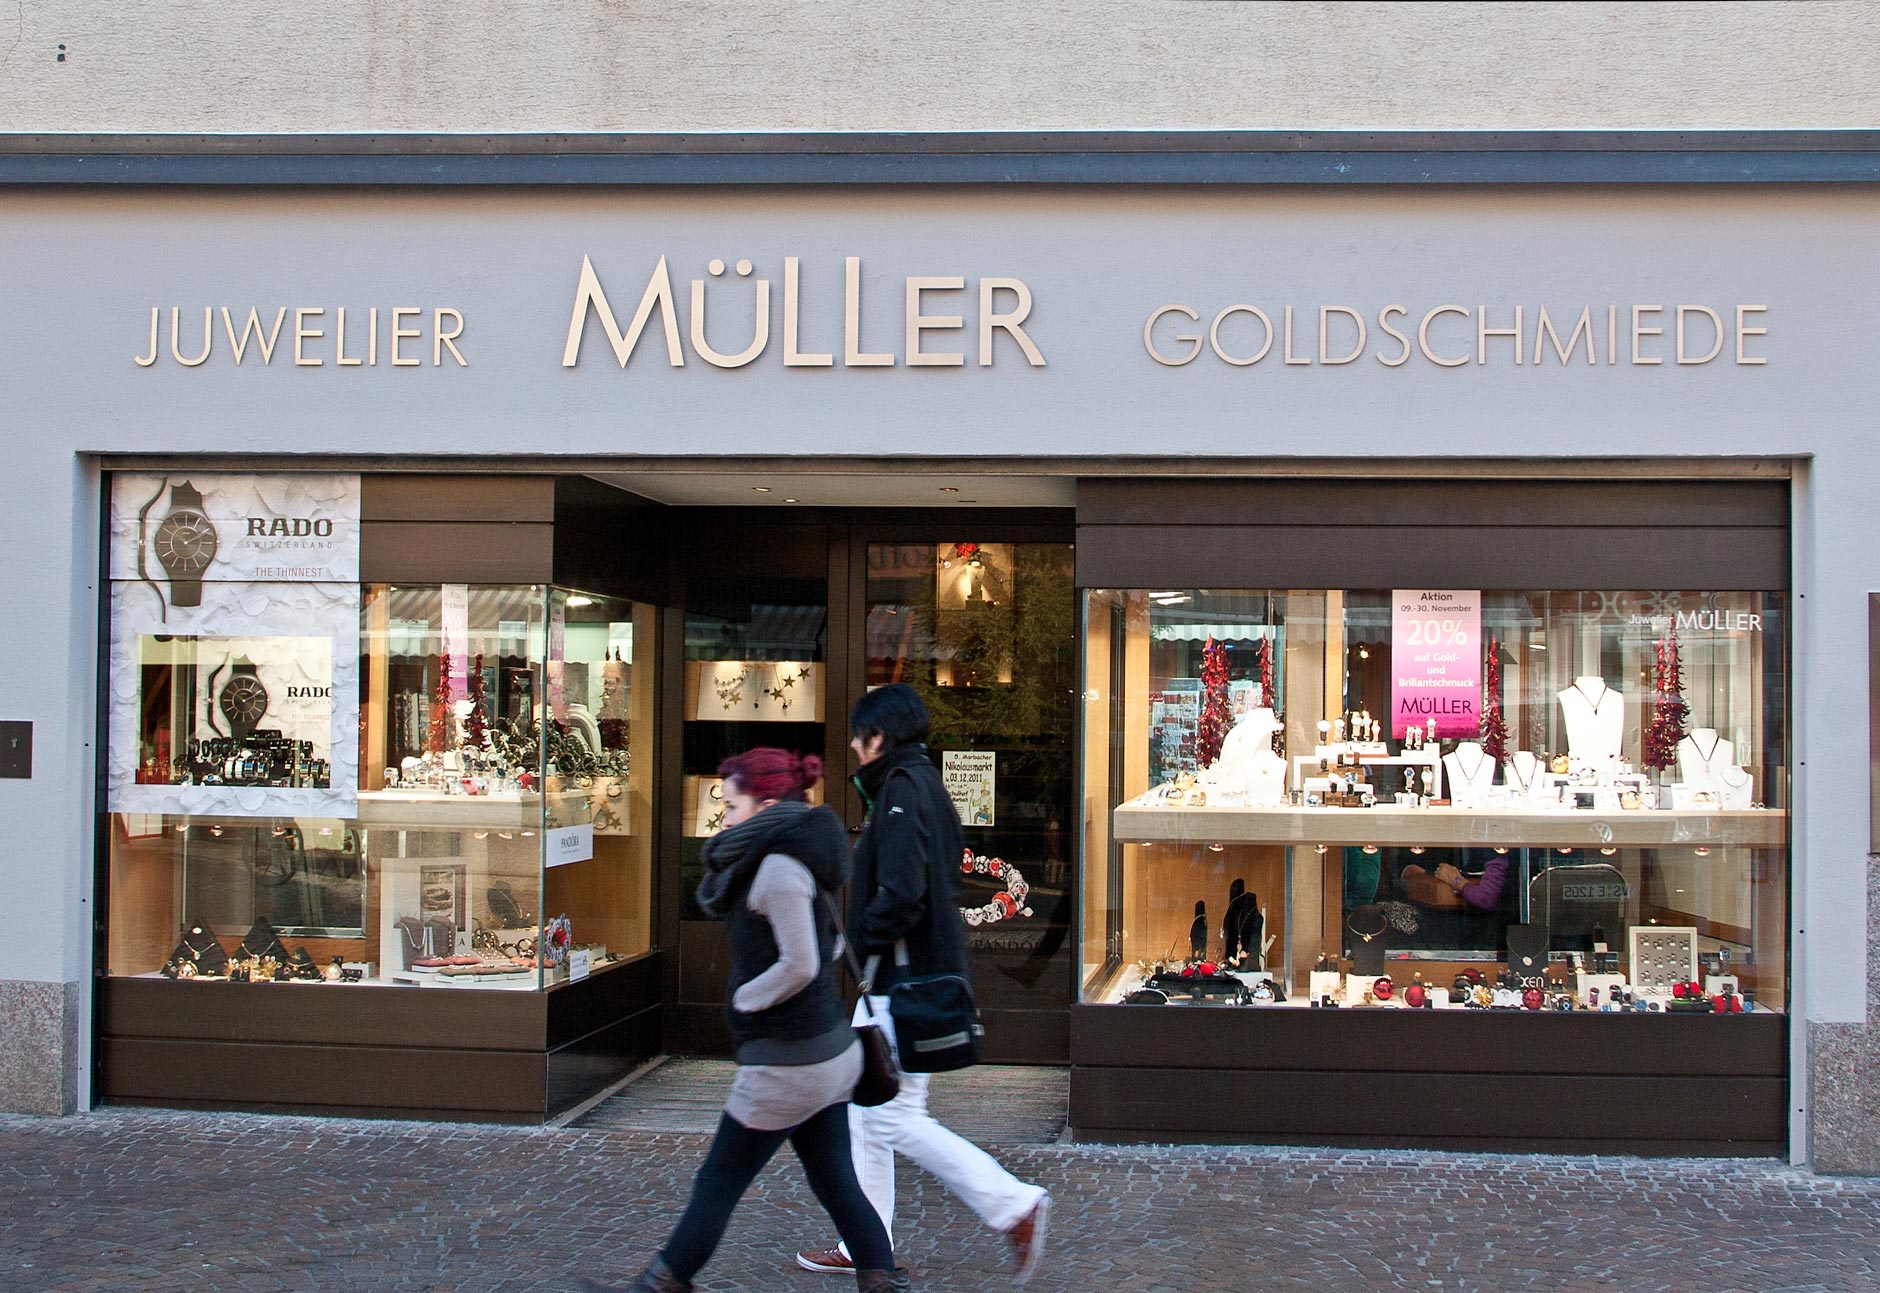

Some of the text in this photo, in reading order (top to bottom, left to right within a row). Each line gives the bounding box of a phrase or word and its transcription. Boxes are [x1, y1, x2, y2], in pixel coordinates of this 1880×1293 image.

[133, 253, 1769, 369] JUWELIER MÜLLER GOLDSCHMIEDE
[246, 517, 333, 537] RADO
[246, 541, 333, 549] SWITZERLAND
[255, 567, 323, 577] THE THINNEST
[1420, 592, 1453, 601] Aktion
[1400, 604, 1472, 613] 09.-30. November
[1628, 609, 1763, 631] Juwelier MÜLLER
[1406, 619, 1468, 646] 20%
[1414, 652, 1461, 662] auf Gold-
[1427, 665, 1446, 674] und
[1398, 677, 1474, 687] Brillantschmuck
[1400, 697, 1473, 714] MÜLLER
[945, 761, 993, 772] Nikolausmarkt
[949, 773, 983, 783] 03.12.2011
